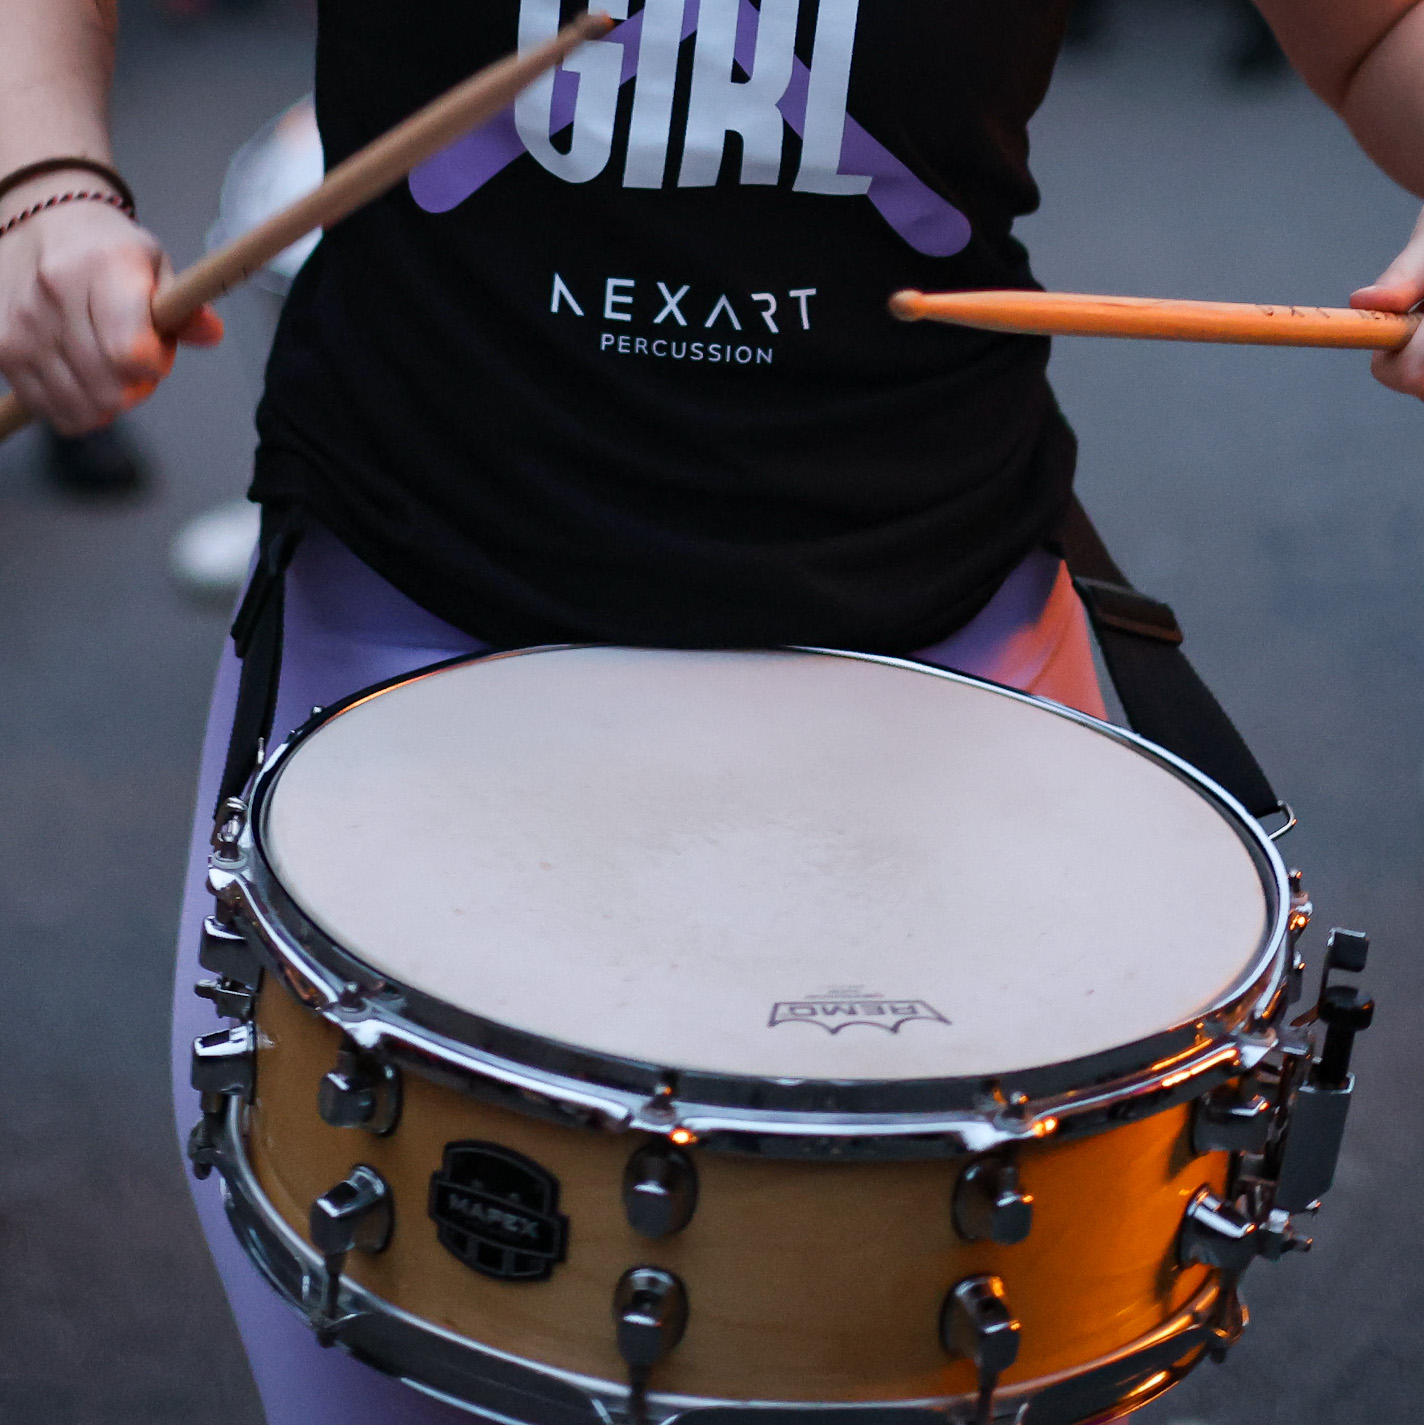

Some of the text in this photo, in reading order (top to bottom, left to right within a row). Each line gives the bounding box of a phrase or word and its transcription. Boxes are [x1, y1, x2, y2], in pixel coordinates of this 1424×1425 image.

[550, 272, 818, 334] NEXART
[599, 332, 774, 365] PERCUSSION
[788, 1003, 919, 1017] REMO
[446, 1192, 540, 1240] MAPEX
